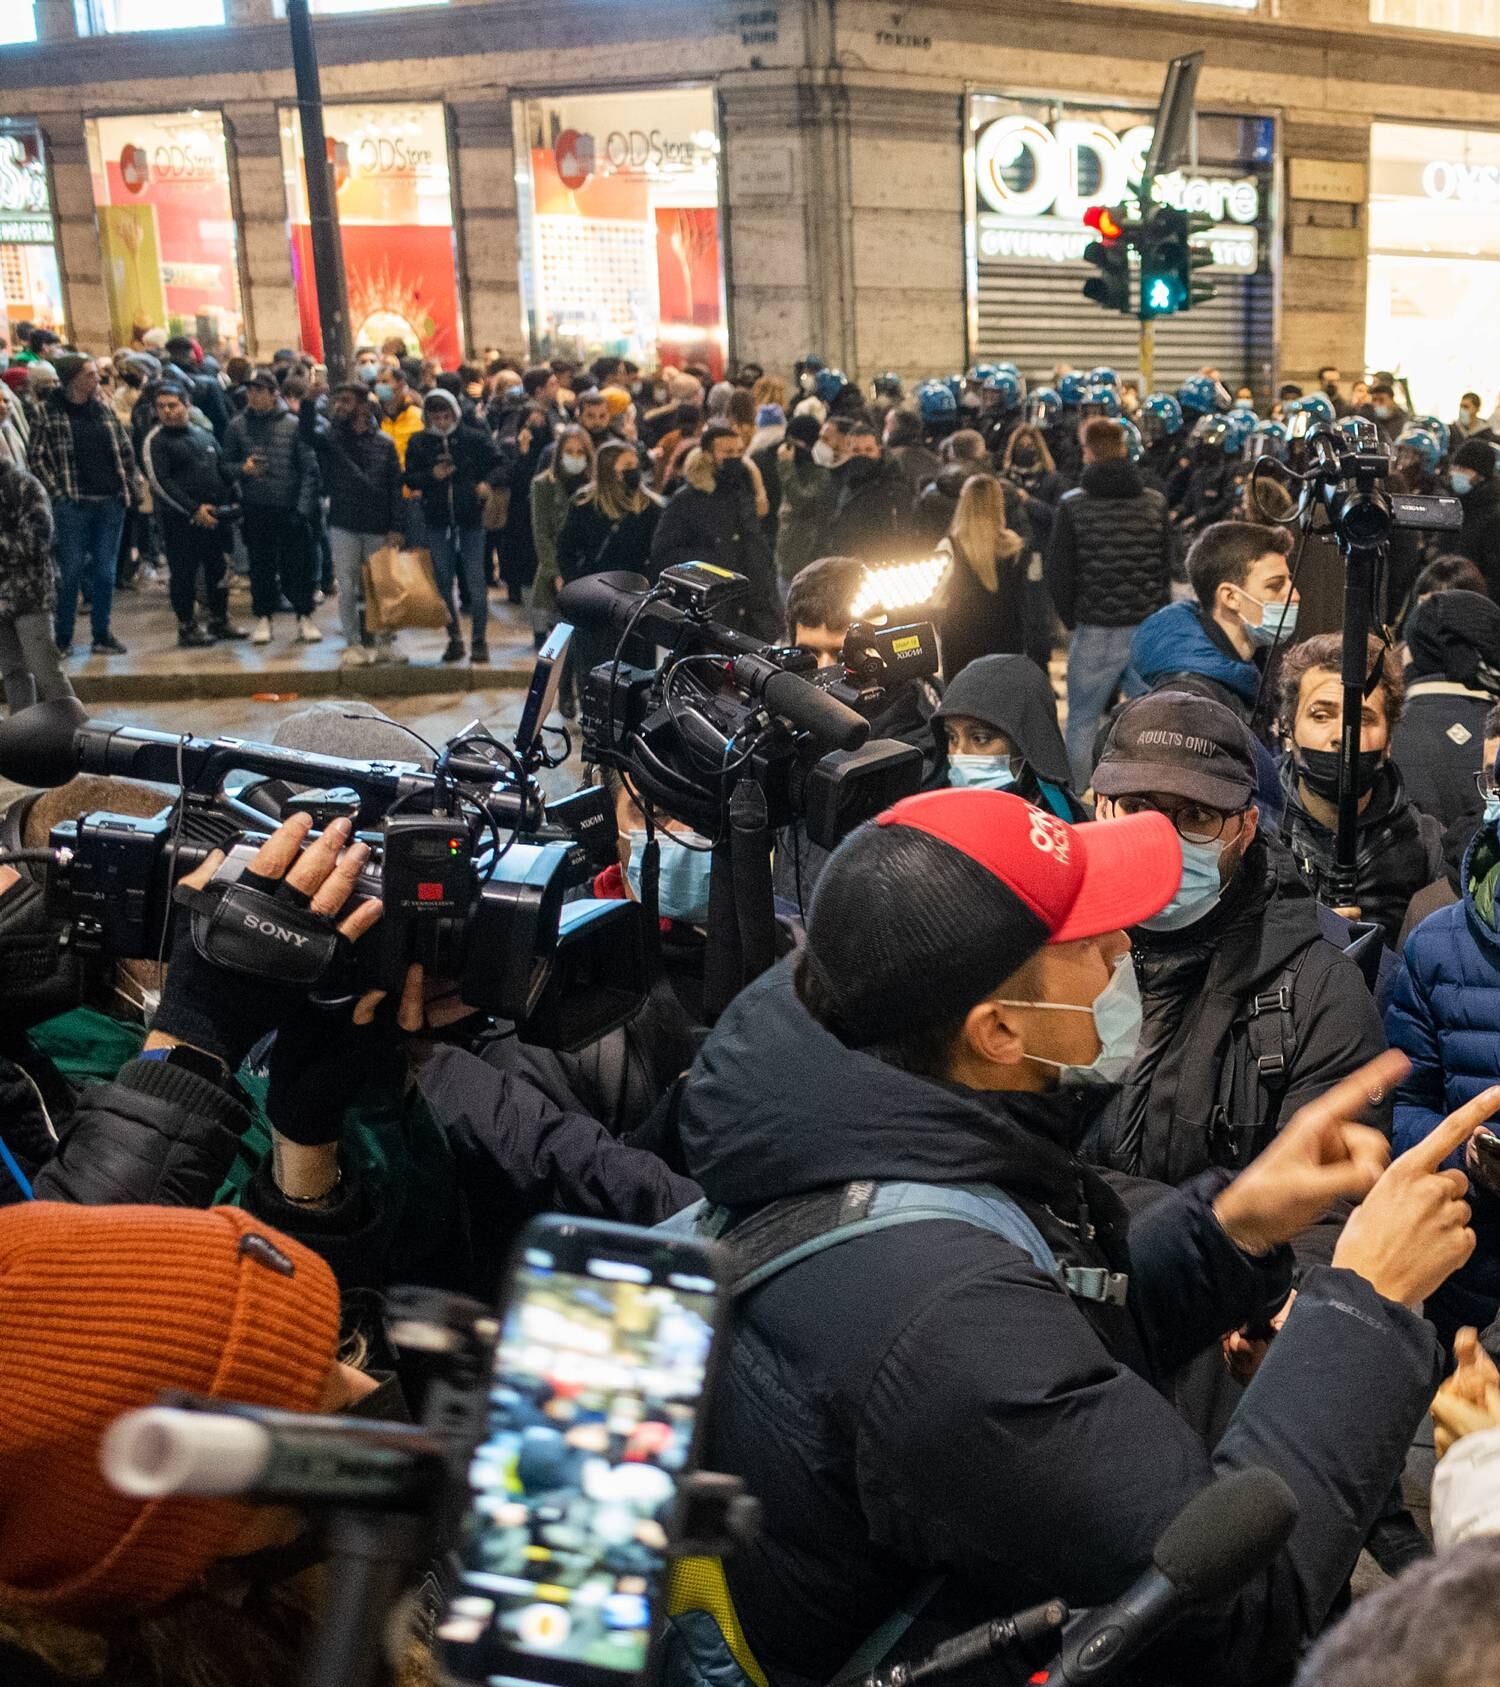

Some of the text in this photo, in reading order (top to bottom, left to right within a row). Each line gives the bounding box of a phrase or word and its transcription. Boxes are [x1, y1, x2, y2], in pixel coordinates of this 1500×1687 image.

[1136, 730, 1217, 758] ADULTS ONLY
[243, 914, 309, 948] SONY
